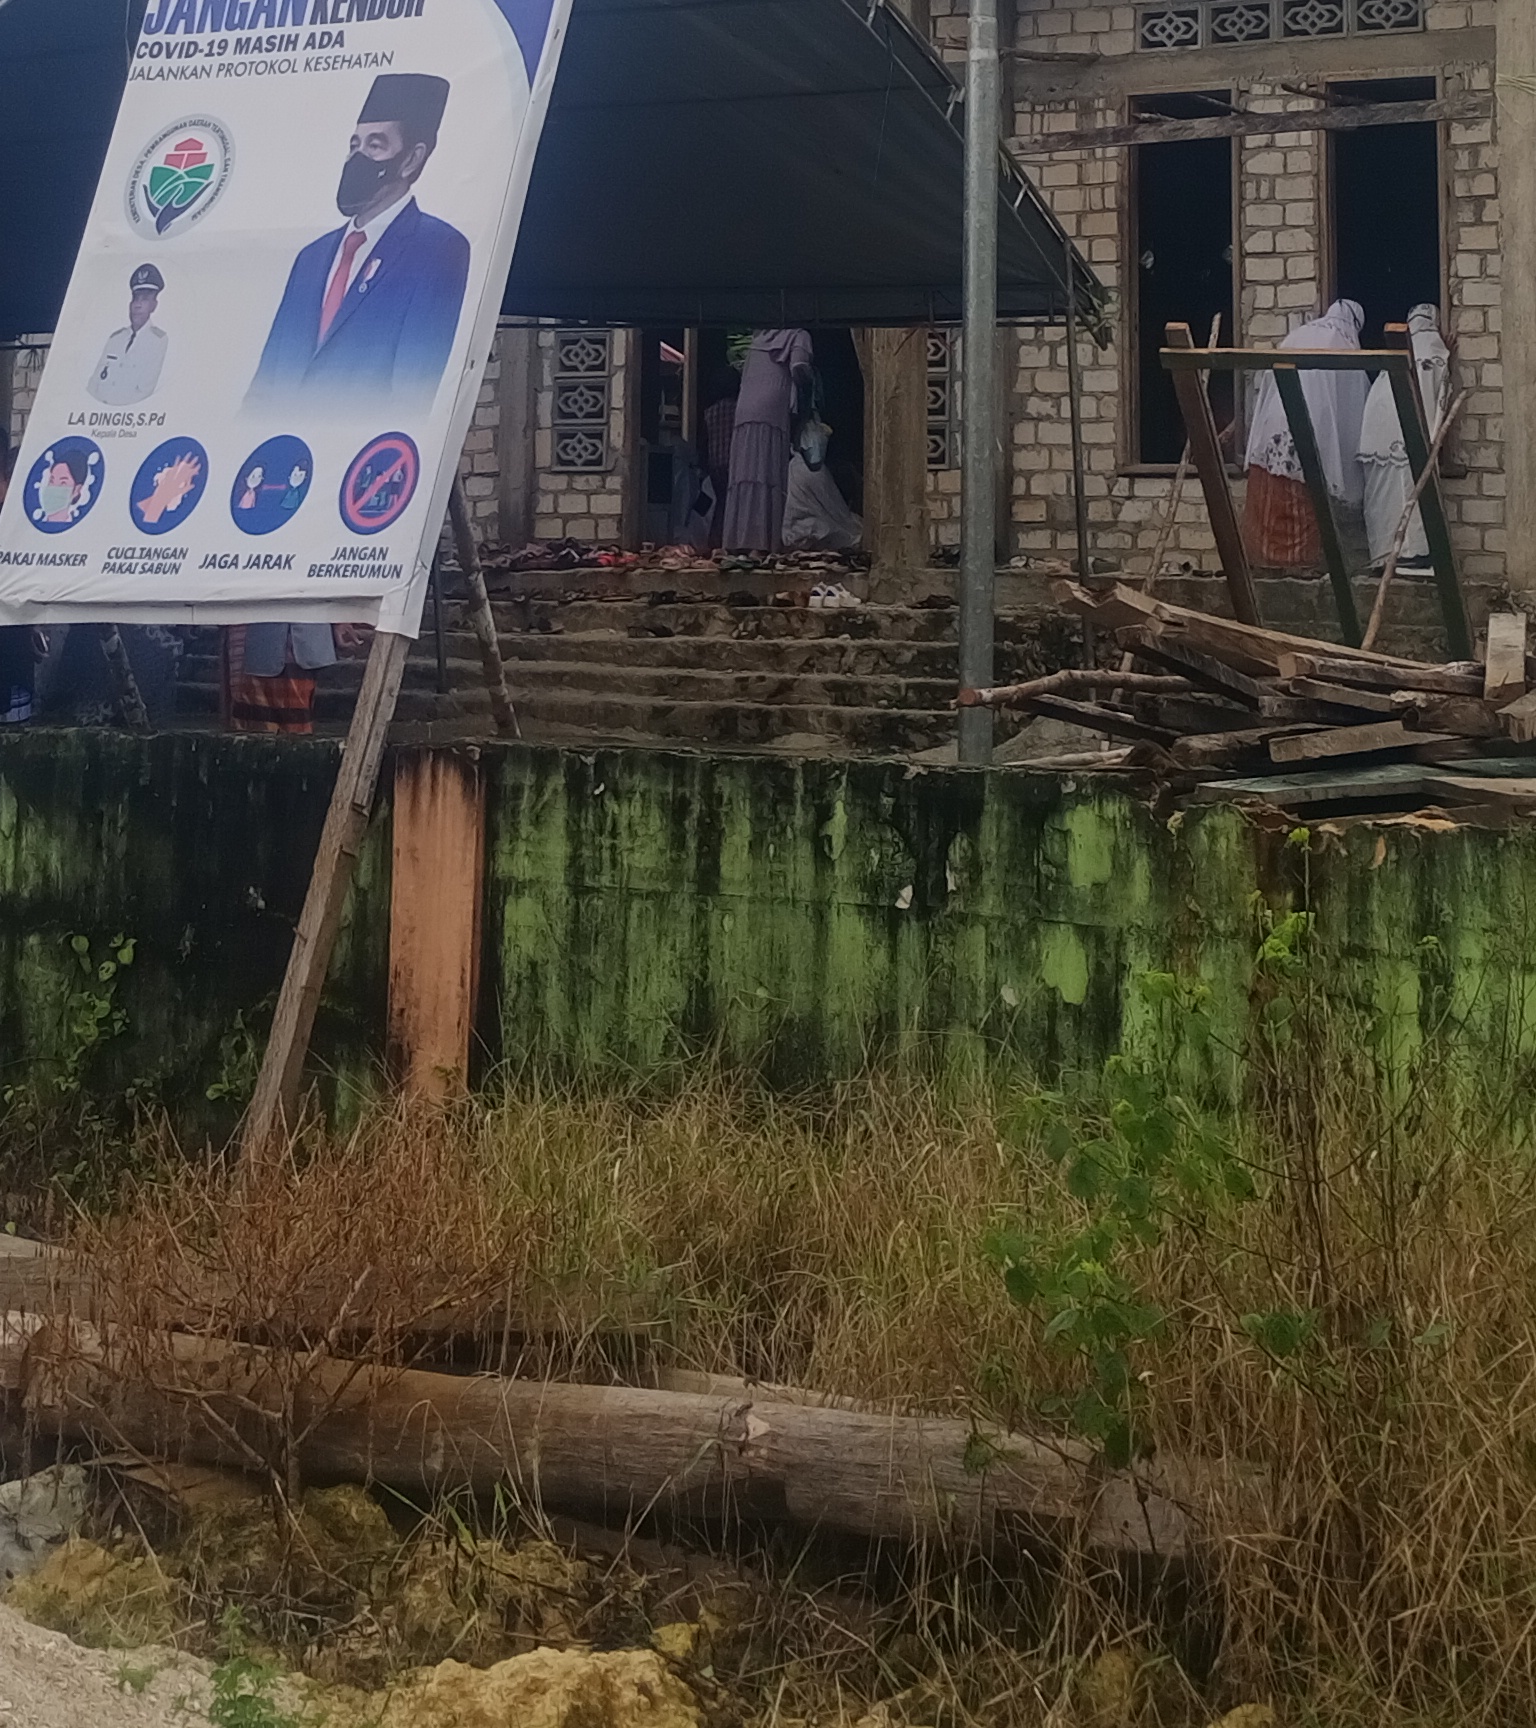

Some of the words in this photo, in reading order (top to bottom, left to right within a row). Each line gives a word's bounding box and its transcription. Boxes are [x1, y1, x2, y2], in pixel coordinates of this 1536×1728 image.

[136, 38, 229, 60] COVID-19
[233, 33, 301, 55] MASIH
[303, 30, 345, 51] ADA
[129, 63, 213, 81] JALANKAN
[215, 58, 298, 79] PROTOKOL
[303, 50, 395, 72] KESEHATAN
[67, 412, 85, 426] LA
[88, 412, 166, 428] DINGIS,S.Pd
[118, 429, 138, 438] Desa
[36, 552, 88, 567] MASKER
[107, 547, 139, 560] CUCI
[139, 547, 189, 560] TANGAN
[330, 546, 389, 561] JANGAN
[101, 562, 138, 575] PAKAI
[138, 562, 182, 575] SABUN
[198, 553, 240, 570] JAGA
[242, 553, 296, 570] JARAK
[307, 563, 403, 579] BERKERUMUN
